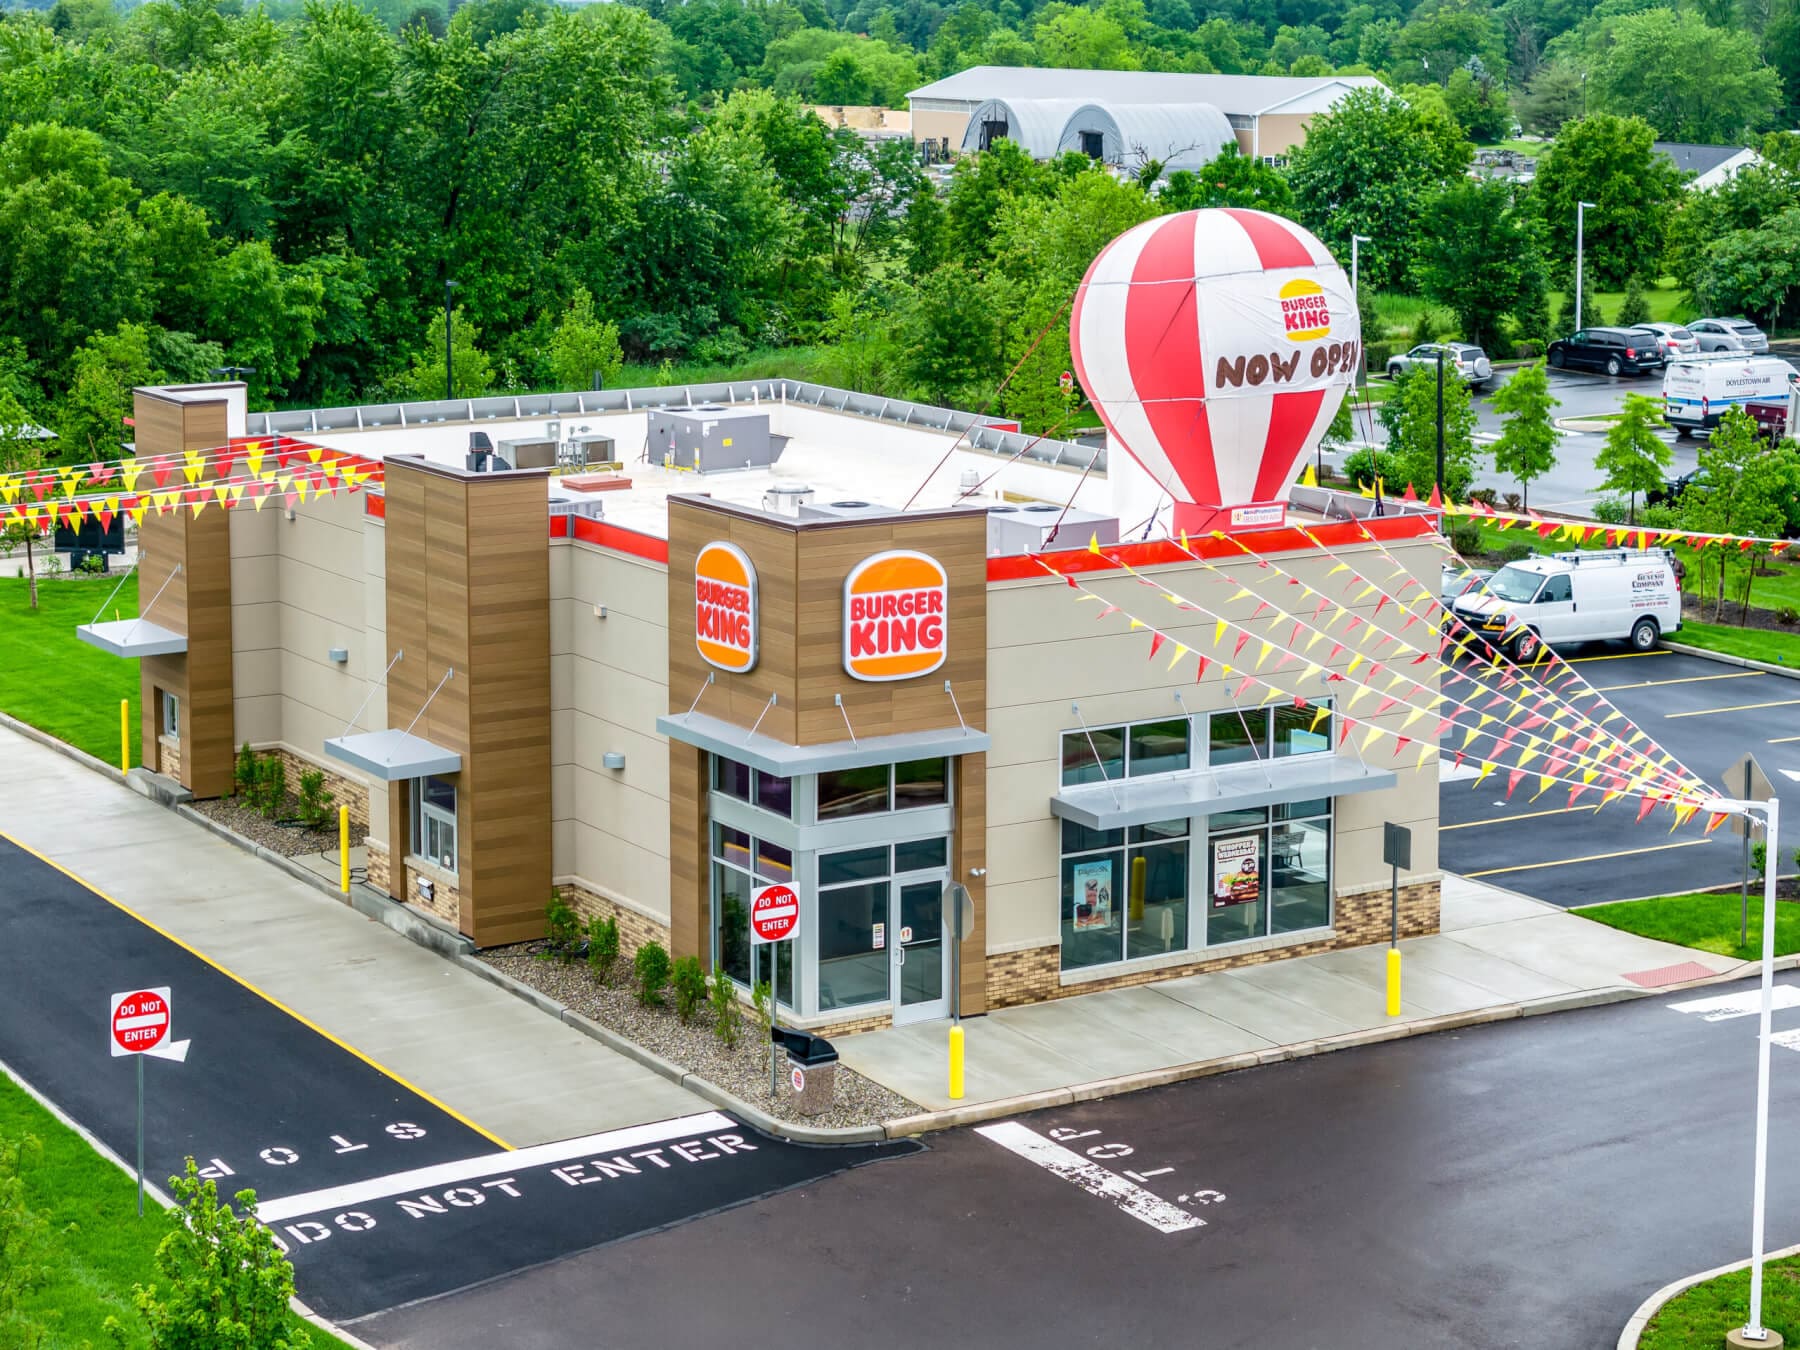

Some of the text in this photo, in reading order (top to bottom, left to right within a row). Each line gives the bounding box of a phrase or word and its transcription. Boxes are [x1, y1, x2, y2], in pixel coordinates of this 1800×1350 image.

[1281, 295, 1327, 312] BURGER
[1284, 309, 1330, 331] KING
[1216, 340, 1359, 388] NOW OPEN
[1726, 376, 1771, 387] DOYLESTOWN AIR
[1632, 580, 1664, 588] COMPANY
[697, 579, 750, 614] BURGER
[851, 590, 943, 621] BURGER
[697, 603, 750, 648] KING
[850, 615, 943, 657] KING
[759, 893, 792, 908] DO NOT
[762, 919, 789, 932] ENTER
[121, 1000, 161, 1016] DO NOT
[124, 1027, 157, 1043] ENTER
[198, 1122, 427, 1179] STOP
[284, 1134, 759, 1244] DO NOT ENTER
